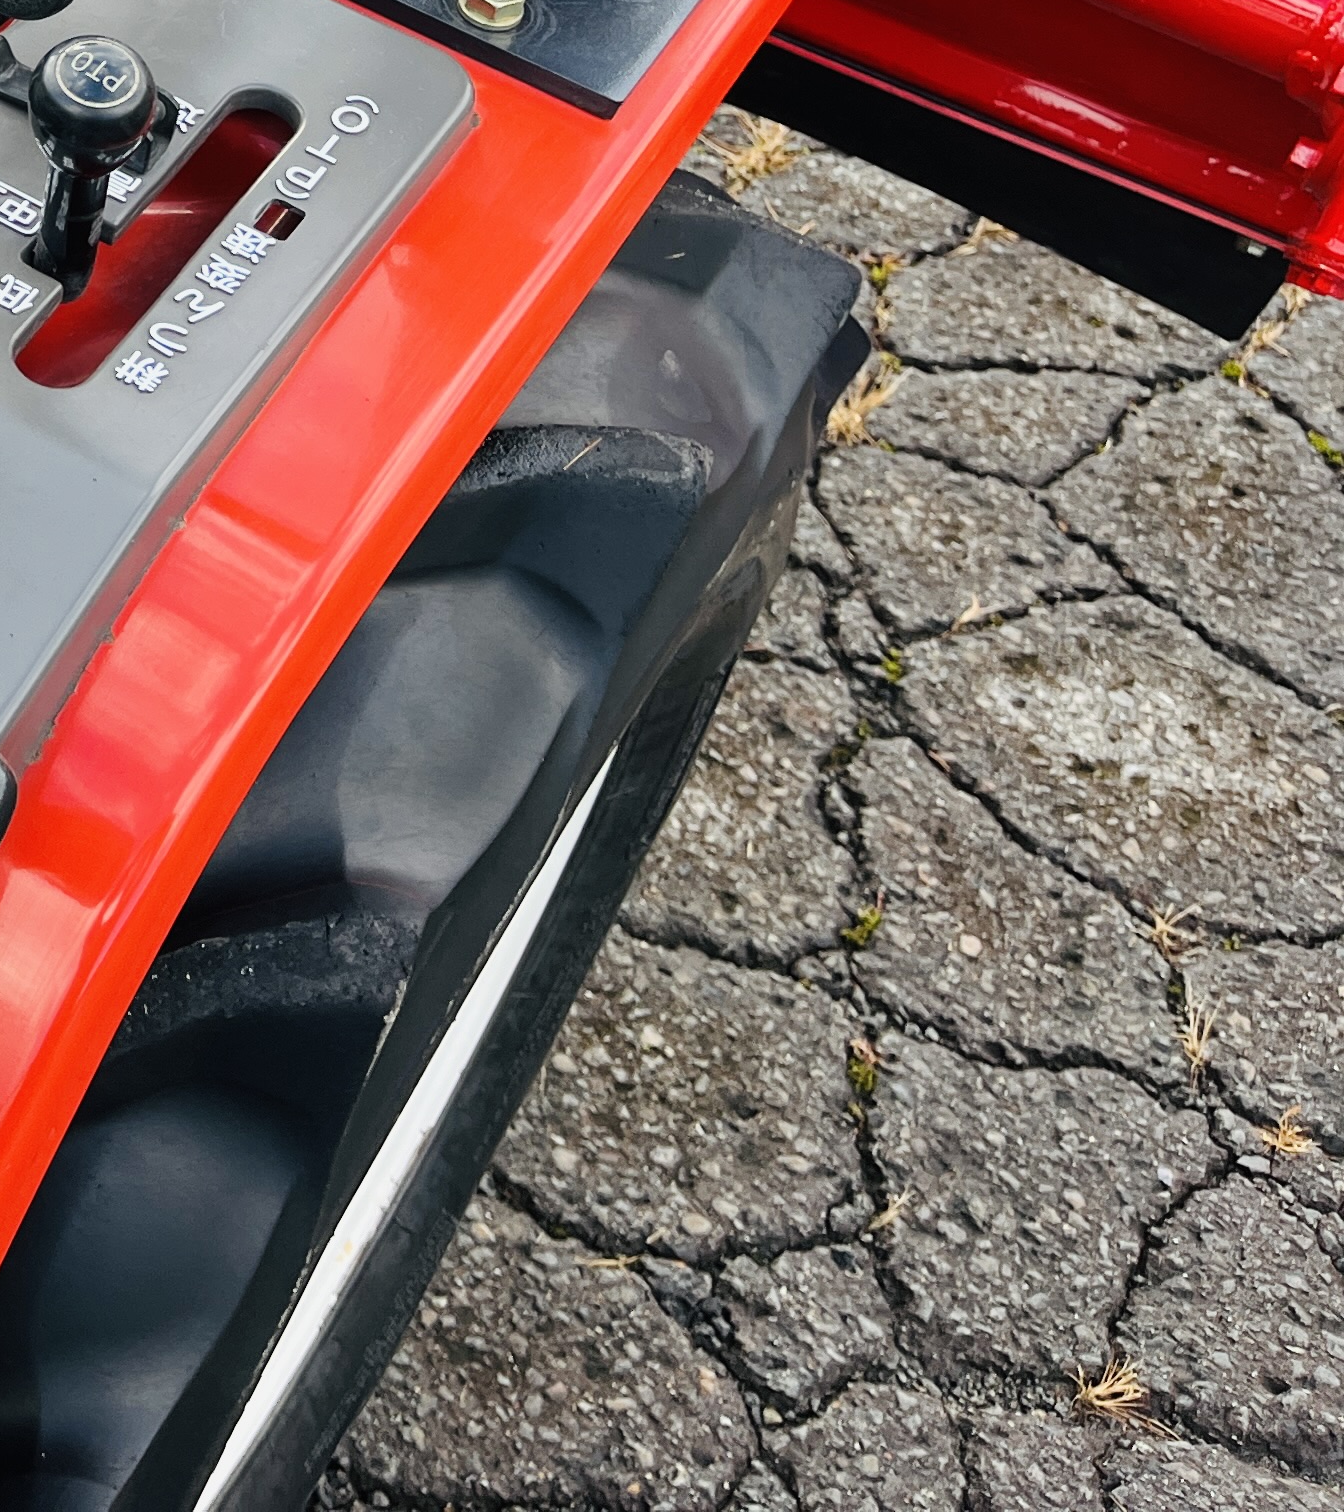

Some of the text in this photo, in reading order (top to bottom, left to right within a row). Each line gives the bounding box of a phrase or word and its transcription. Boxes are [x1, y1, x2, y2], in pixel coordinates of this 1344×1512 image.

[69, 42, 128, 96] PTO
[109, 87, 381, 398] 耕うん変速 (PTO)
